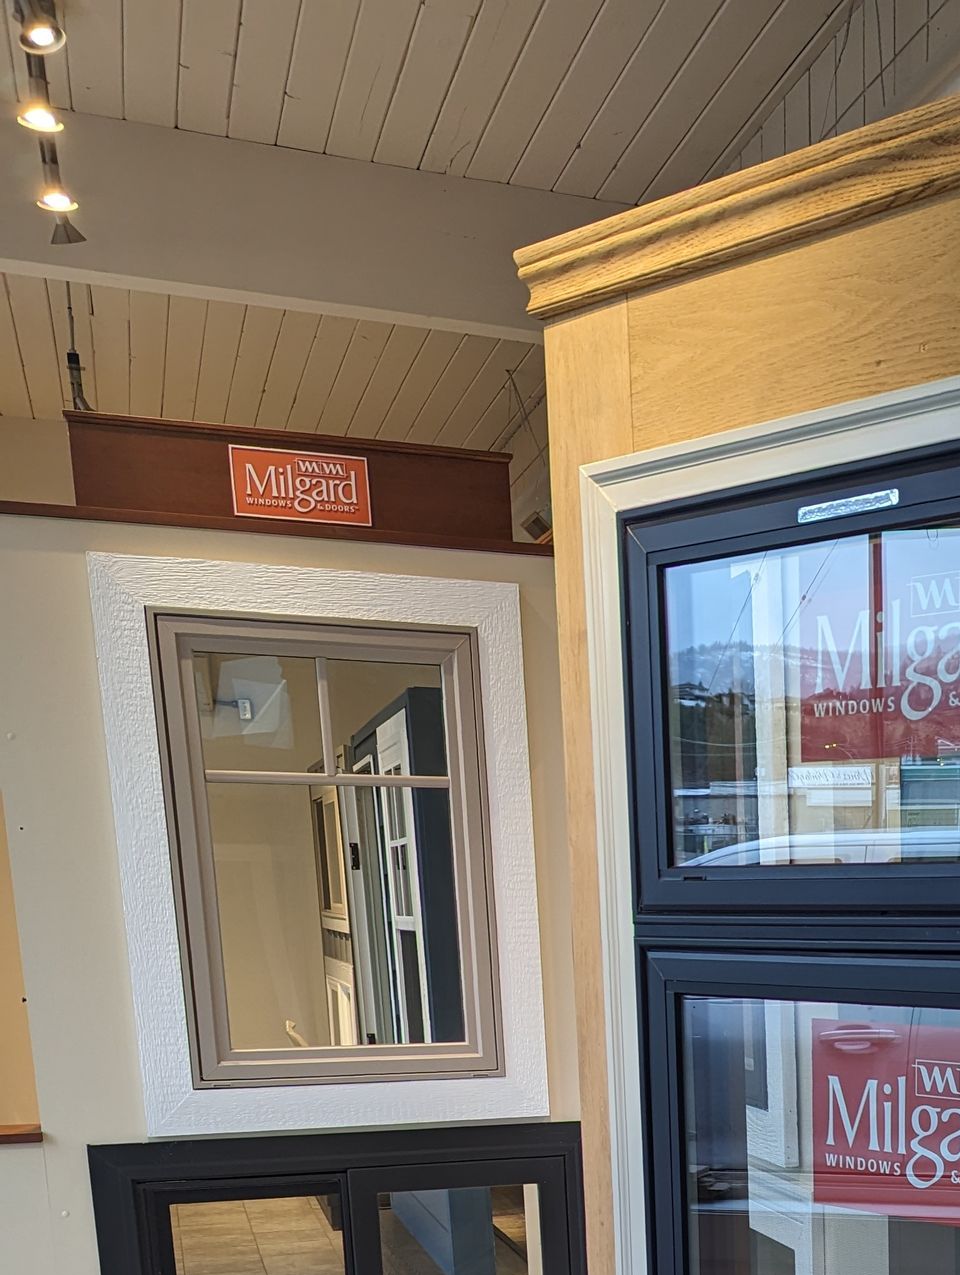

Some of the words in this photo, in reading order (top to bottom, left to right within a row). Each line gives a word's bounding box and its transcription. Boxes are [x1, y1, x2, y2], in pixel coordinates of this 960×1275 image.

[245, 463, 358, 513] Milgard
[245, 497, 293, 508] WINDOWS
[326, 504, 355, 513] DOORS
[813, 696, 896, 718] WINDOWS
[949, 691, 960, 706] &
[825, 1153, 901, 1176] WINDOWS
